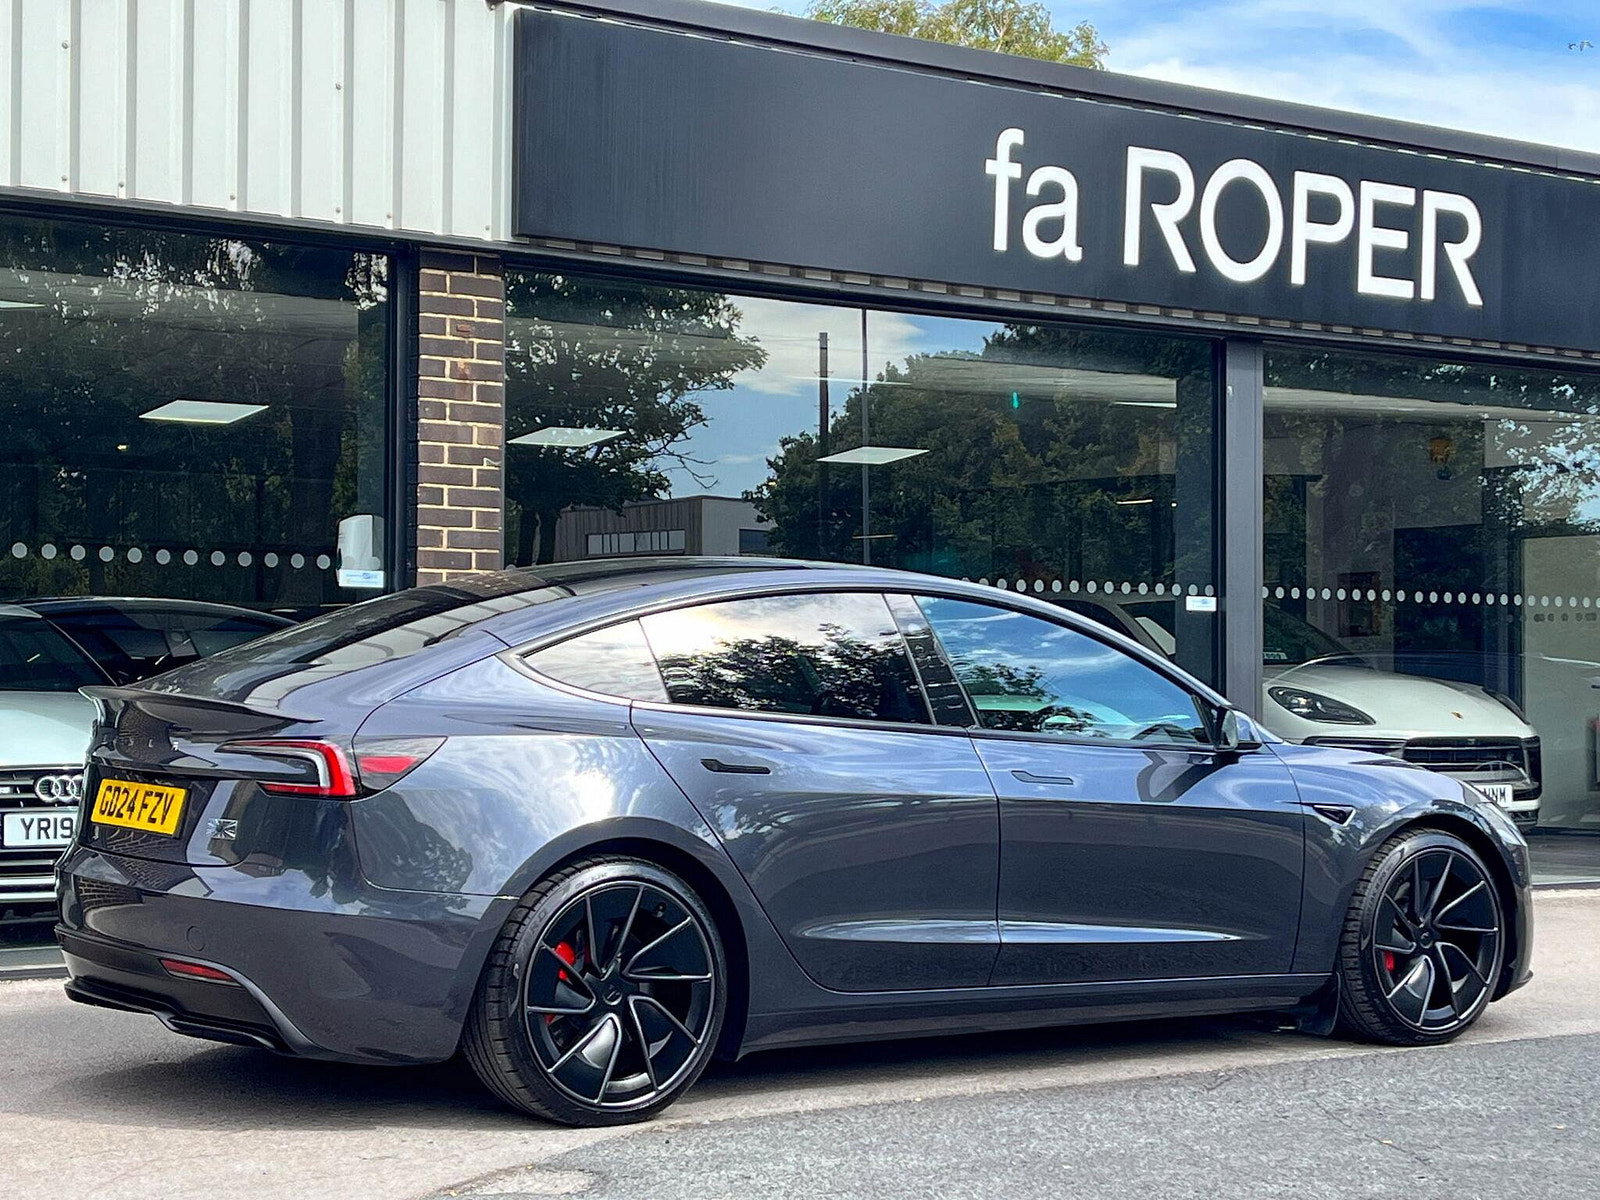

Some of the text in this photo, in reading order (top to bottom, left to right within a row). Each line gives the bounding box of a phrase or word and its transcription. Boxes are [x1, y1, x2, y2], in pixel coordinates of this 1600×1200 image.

[984, 127, 1484, 306] fa ROPER
[98, 785, 175, 826] GD24 FZV
[20, 817, 75, 841] YR19
